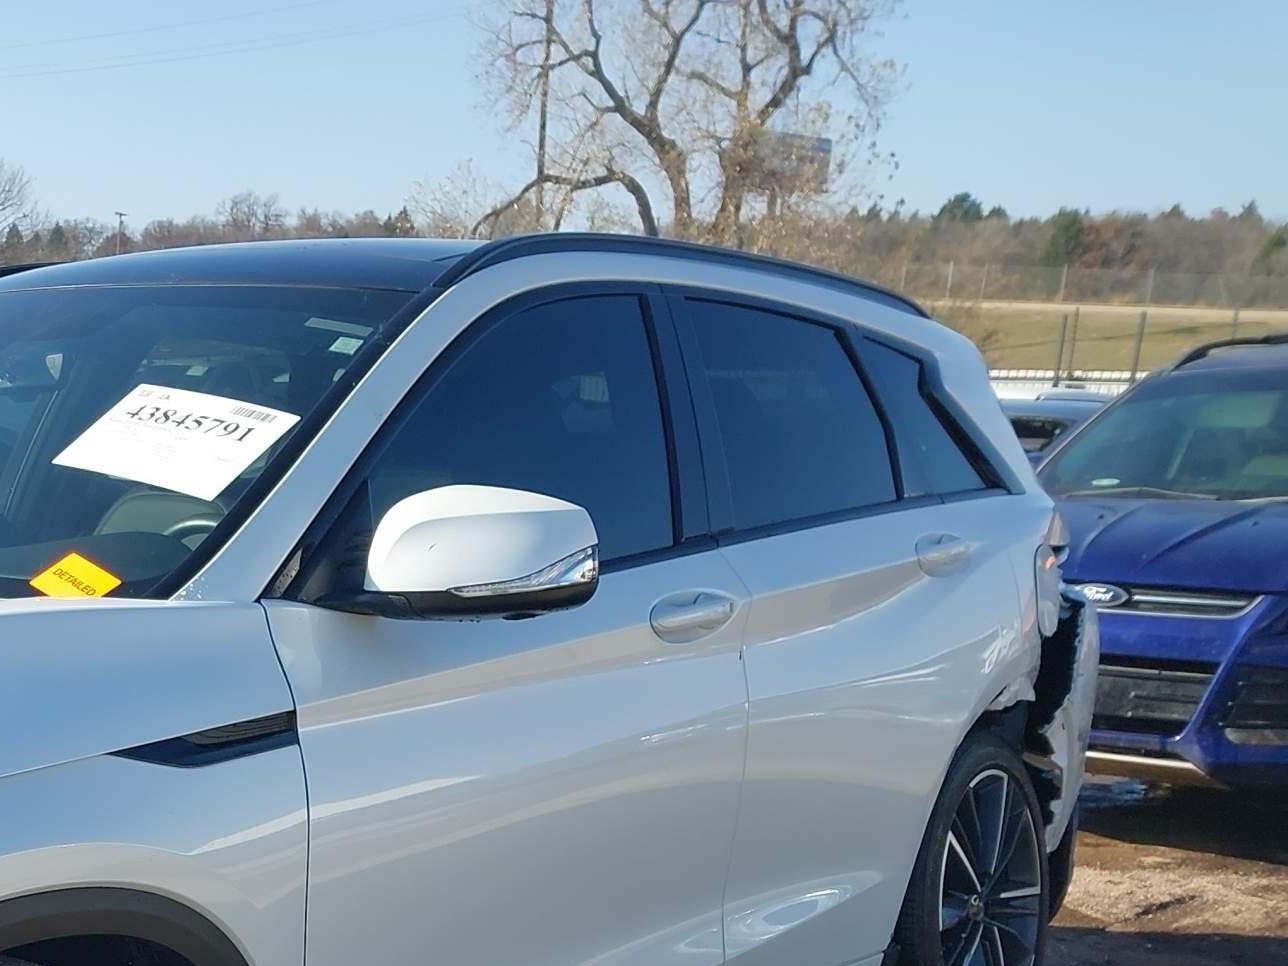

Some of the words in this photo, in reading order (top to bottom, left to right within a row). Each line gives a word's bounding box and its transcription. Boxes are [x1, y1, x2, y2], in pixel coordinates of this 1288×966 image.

[126, 404, 255, 442] 43845791
[51, 567, 97, 598] DETAILED
[1083, 586, 1114, 601] Ford
